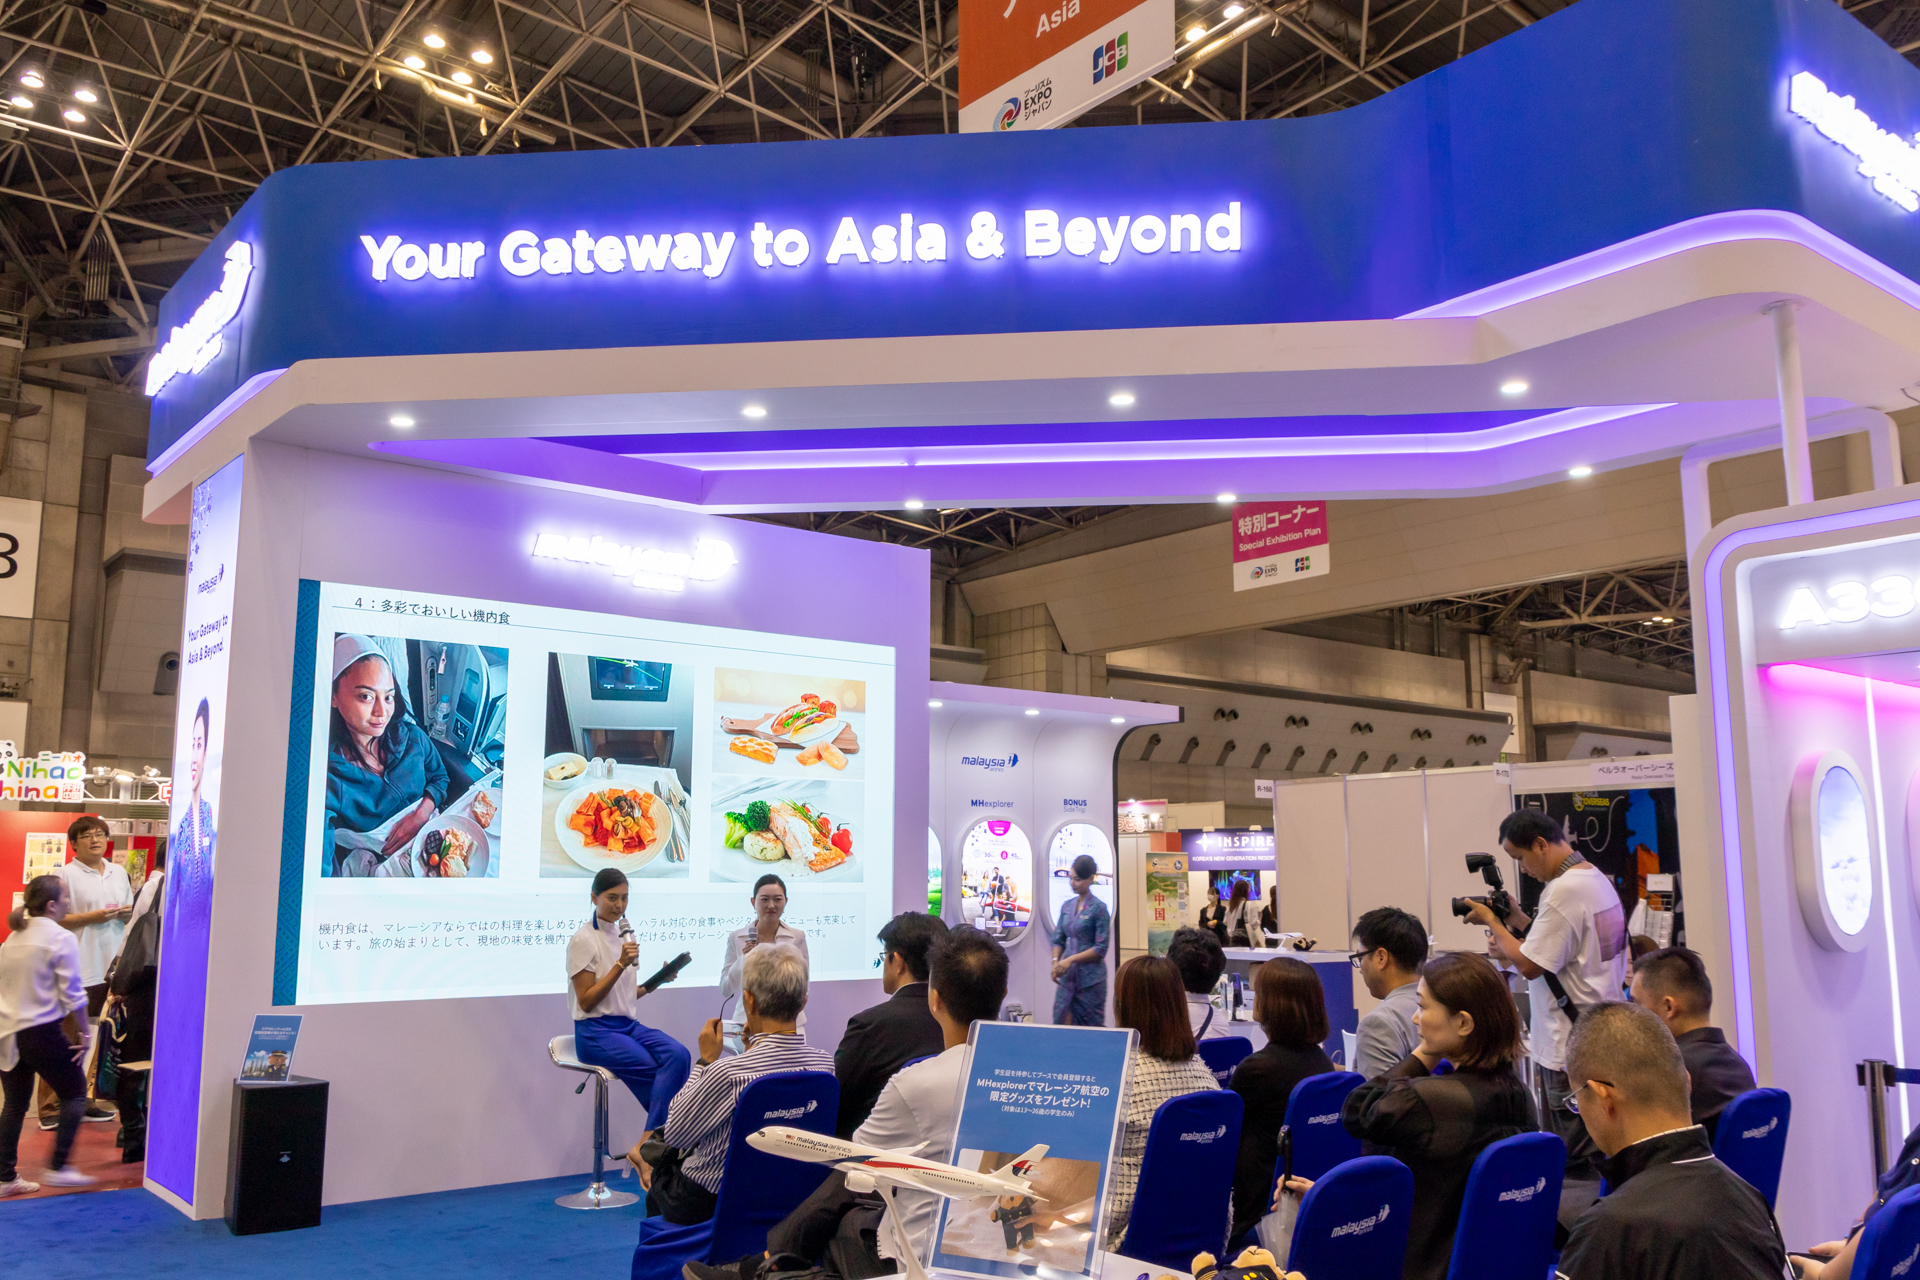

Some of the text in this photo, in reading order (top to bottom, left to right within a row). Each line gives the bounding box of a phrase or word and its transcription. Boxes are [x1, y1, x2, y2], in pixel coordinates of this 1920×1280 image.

[1036, 0, 1080, 38] Asia
[1093, 38, 1128, 80] JCB
[1024, 77, 1052, 97] ツーリズム
[1024, 87, 1052, 110] EXPO
[1024, 99, 1052, 121] ジャパン
[359, 201, 1241, 282] Your Gateway to Asia & Beyond
[1238, 504, 1319, 536] 特別コーナー
[1239, 527, 1321, 552] Special Exhibition Plan
[1780, 575, 1920, 630] A33
[188, 614, 229, 643] Your Gateway to
[188, 651, 199, 665] Asia
[41, 753, 82, 763] ニーハオ
[961, 755, 1005, 769] malaysia
[7, 760, 82, 780] Nihao
[971, 799, 1014, 809] MHexplorer
[1584, 797, 1610, 807] OVERSEAS
[1218, 836, 1274, 847] INSPIRE
[1154, 892, 1165, 921] 中国
[976, 1078, 1110, 1097] MHexplorerでマレーシア航空の
[764, 1107, 805, 1119] malaysia
[1308, 1112, 1340, 1124] malaysia
[796, 1136, 853, 1153] malaysia airlines
[1180, 1131, 1215, 1143] malaysia
[1498, 1186, 1535, 1202] malaysia
[1331, 1215, 1376, 1238] malaysia
